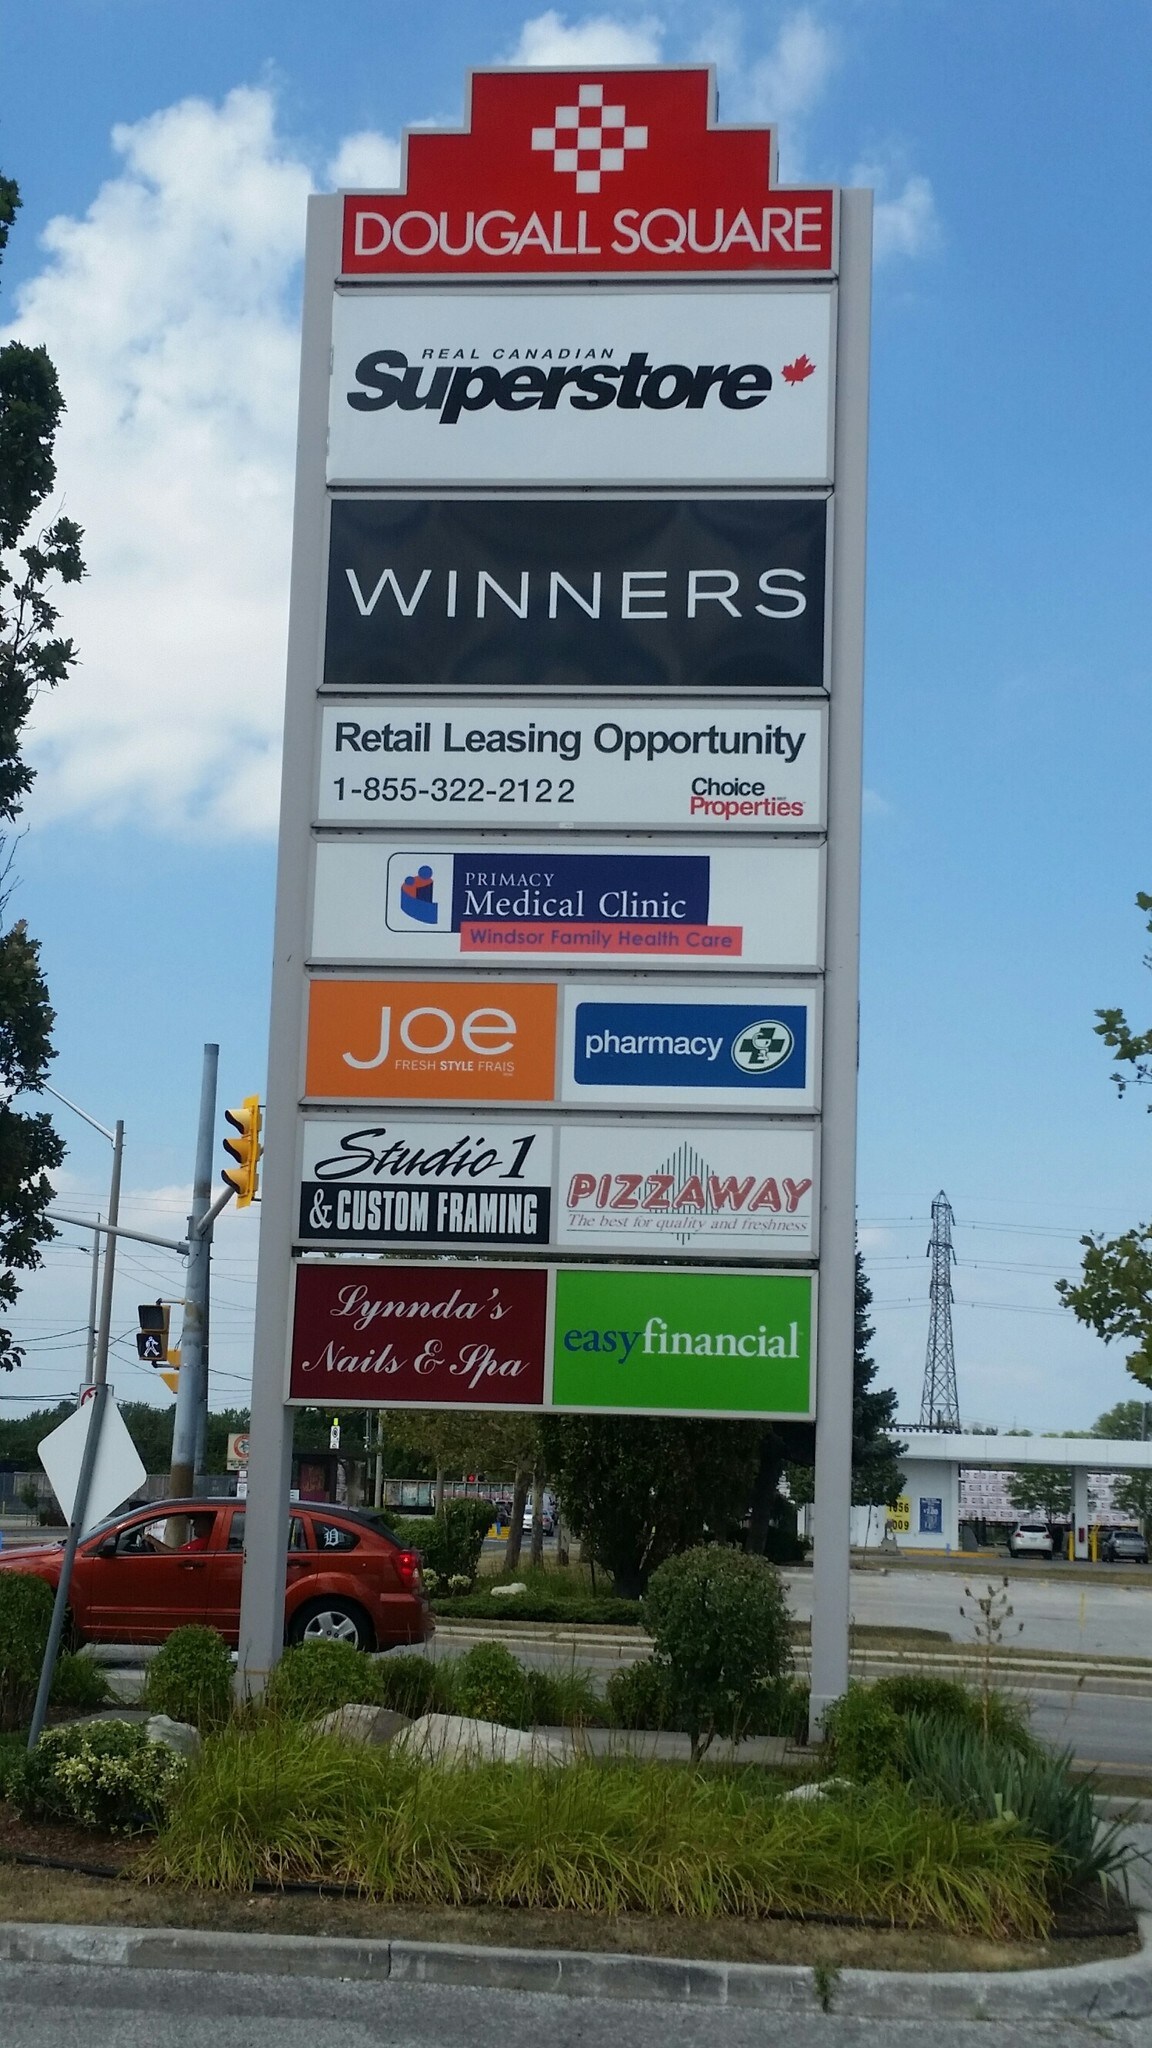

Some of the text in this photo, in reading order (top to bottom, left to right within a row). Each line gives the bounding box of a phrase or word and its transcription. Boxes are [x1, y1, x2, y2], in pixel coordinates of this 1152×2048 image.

[354, 206, 822, 256] DOUGALL SQUARE
[421, 348, 614, 360] REAL CANADIAN
[346, 349, 773, 425] Superstore
[345, 568, 808, 620] WINNERS
[334, 722, 806, 763] Retail Leasing Opportunity
[334, 777, 576, 804] 1-855-322-2122
[691, 777, 765, 797] Choice
[690, 796, 804, 820] Properties
[465, 872, 555, 887] PRIMACY
[463, 889, 687, 919] Medical Clinic
[470, 928, 733, 949] Windsor Family Health Care
[585, 1030, 723, 1061] pharmacy
[395, 1060, 515, 1073] FRESH STYLE FRAIS
[315, 1128, 535, 1180] Studio 1
[567, 1173, 812, 1212] PIZZAWAY
[309, 1188, 538, 1235] & CUSTOM FRAMING
[569, 1213, 808, 1233] The best for quality and freshness
[329, 1284, 513, 1330] Lynnda's
[563, 1317, 800, 1363] easyfinancial
[302, 1335, 531, 1388] Nails & Spa
